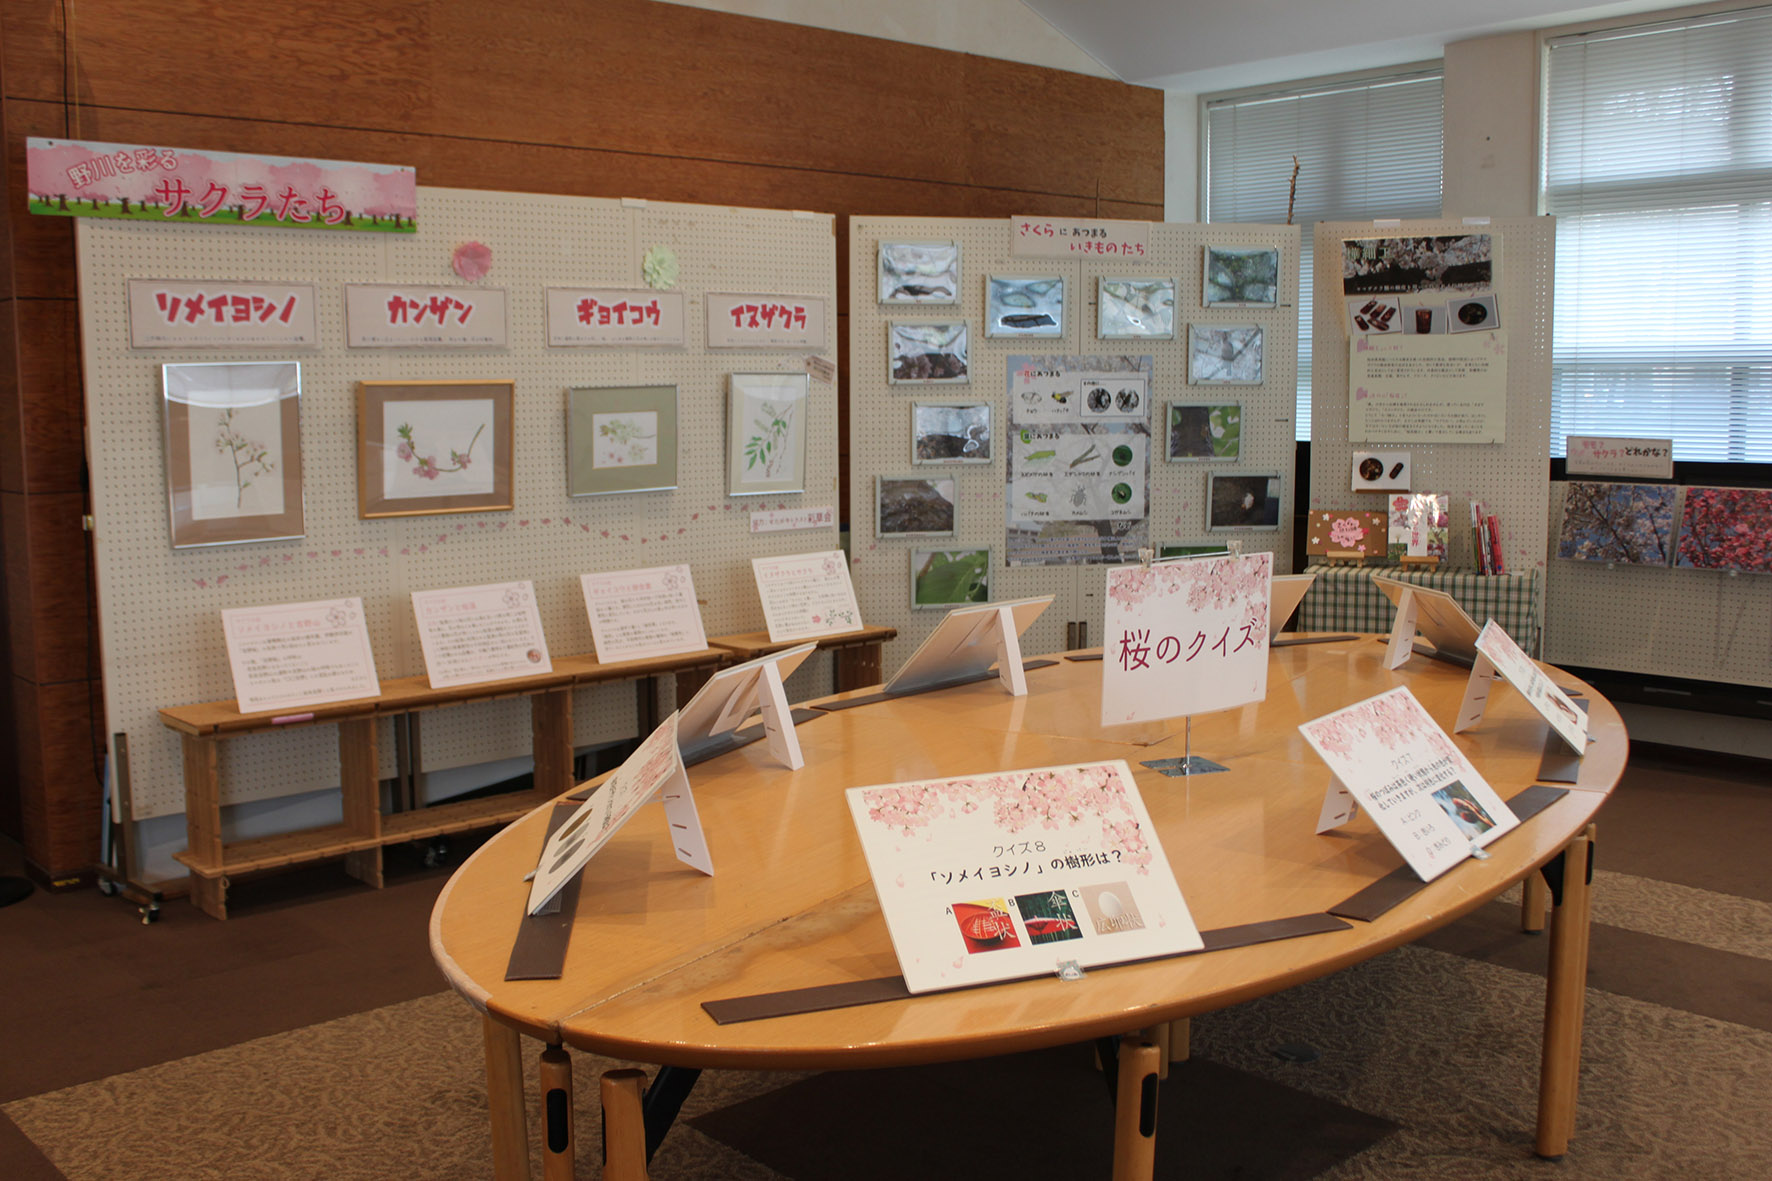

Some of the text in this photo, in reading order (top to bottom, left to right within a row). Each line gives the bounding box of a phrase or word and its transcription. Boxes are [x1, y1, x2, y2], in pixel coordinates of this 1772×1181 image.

[67, 148, 179, 190] 野川を彩る
[154, 177, 347, 225] サクラたち
[155, 292, 296, 324] ソメイヨシノ
[387, 294, 473, 326] カンザン
[575, 297, 662, 328] ギョイコウ
[1118, 617, 1258, 672] 桜のクイズ
[930, 850, 1122, 885] 「ソメイヨシノ」の樹形は？
[1007, 899, 1016, 907] B
[1071, 890, 1080, 898] C
[945, 907, 953, 915] A
[1047, 890, 1080, 933] 傘状
